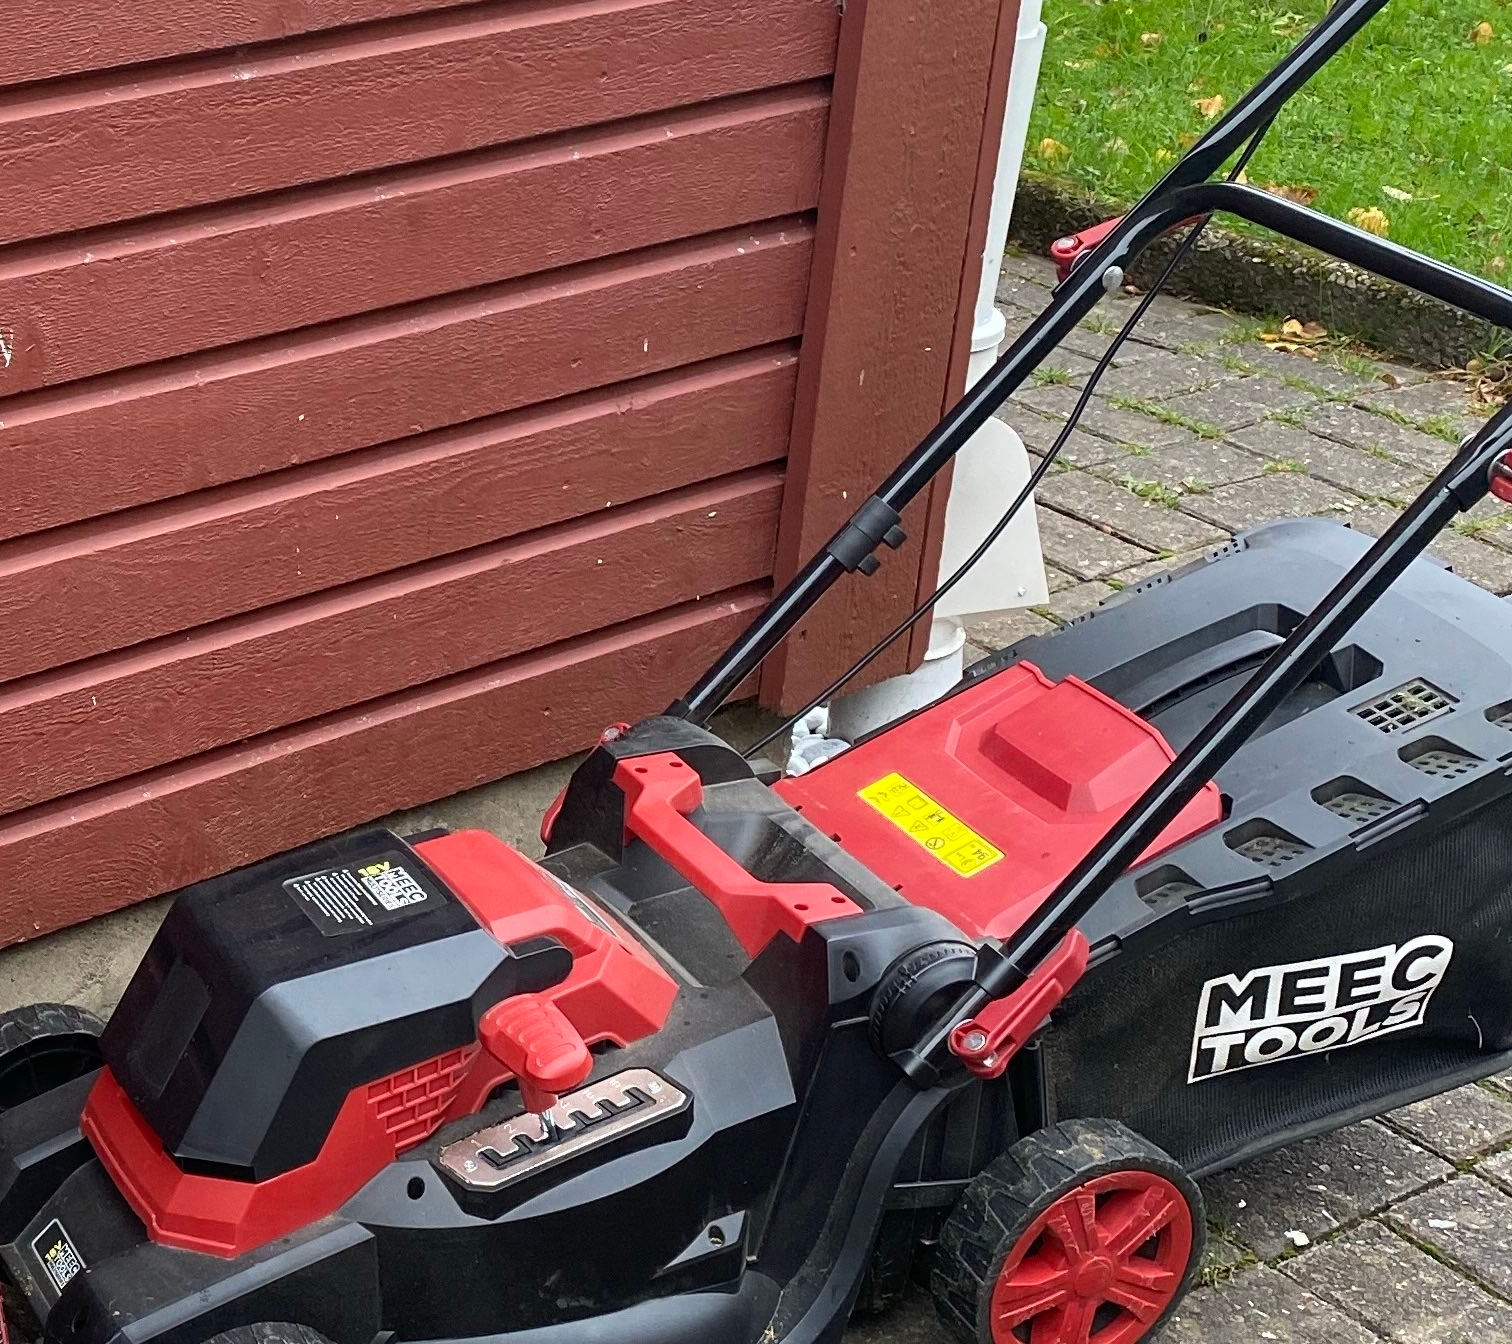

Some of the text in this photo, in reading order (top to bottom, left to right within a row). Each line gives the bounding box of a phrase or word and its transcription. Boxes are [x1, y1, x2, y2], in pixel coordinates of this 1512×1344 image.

[358, 861, 390, 876] 18V
[374, 872, 411, 907] TOOLS
[390, 868, 425, 902] MEEC
[1202, 941, 1446, 1030] MEEC
[1199, 991, 1428, 1073] TOOLS
[502, 1123, 517, 1134] 2
[44, 1239, 62, 1261] 18V
[60, 1244, 80, 1274] MEEC
[53, 1255, 73, 1282] TOOLS
